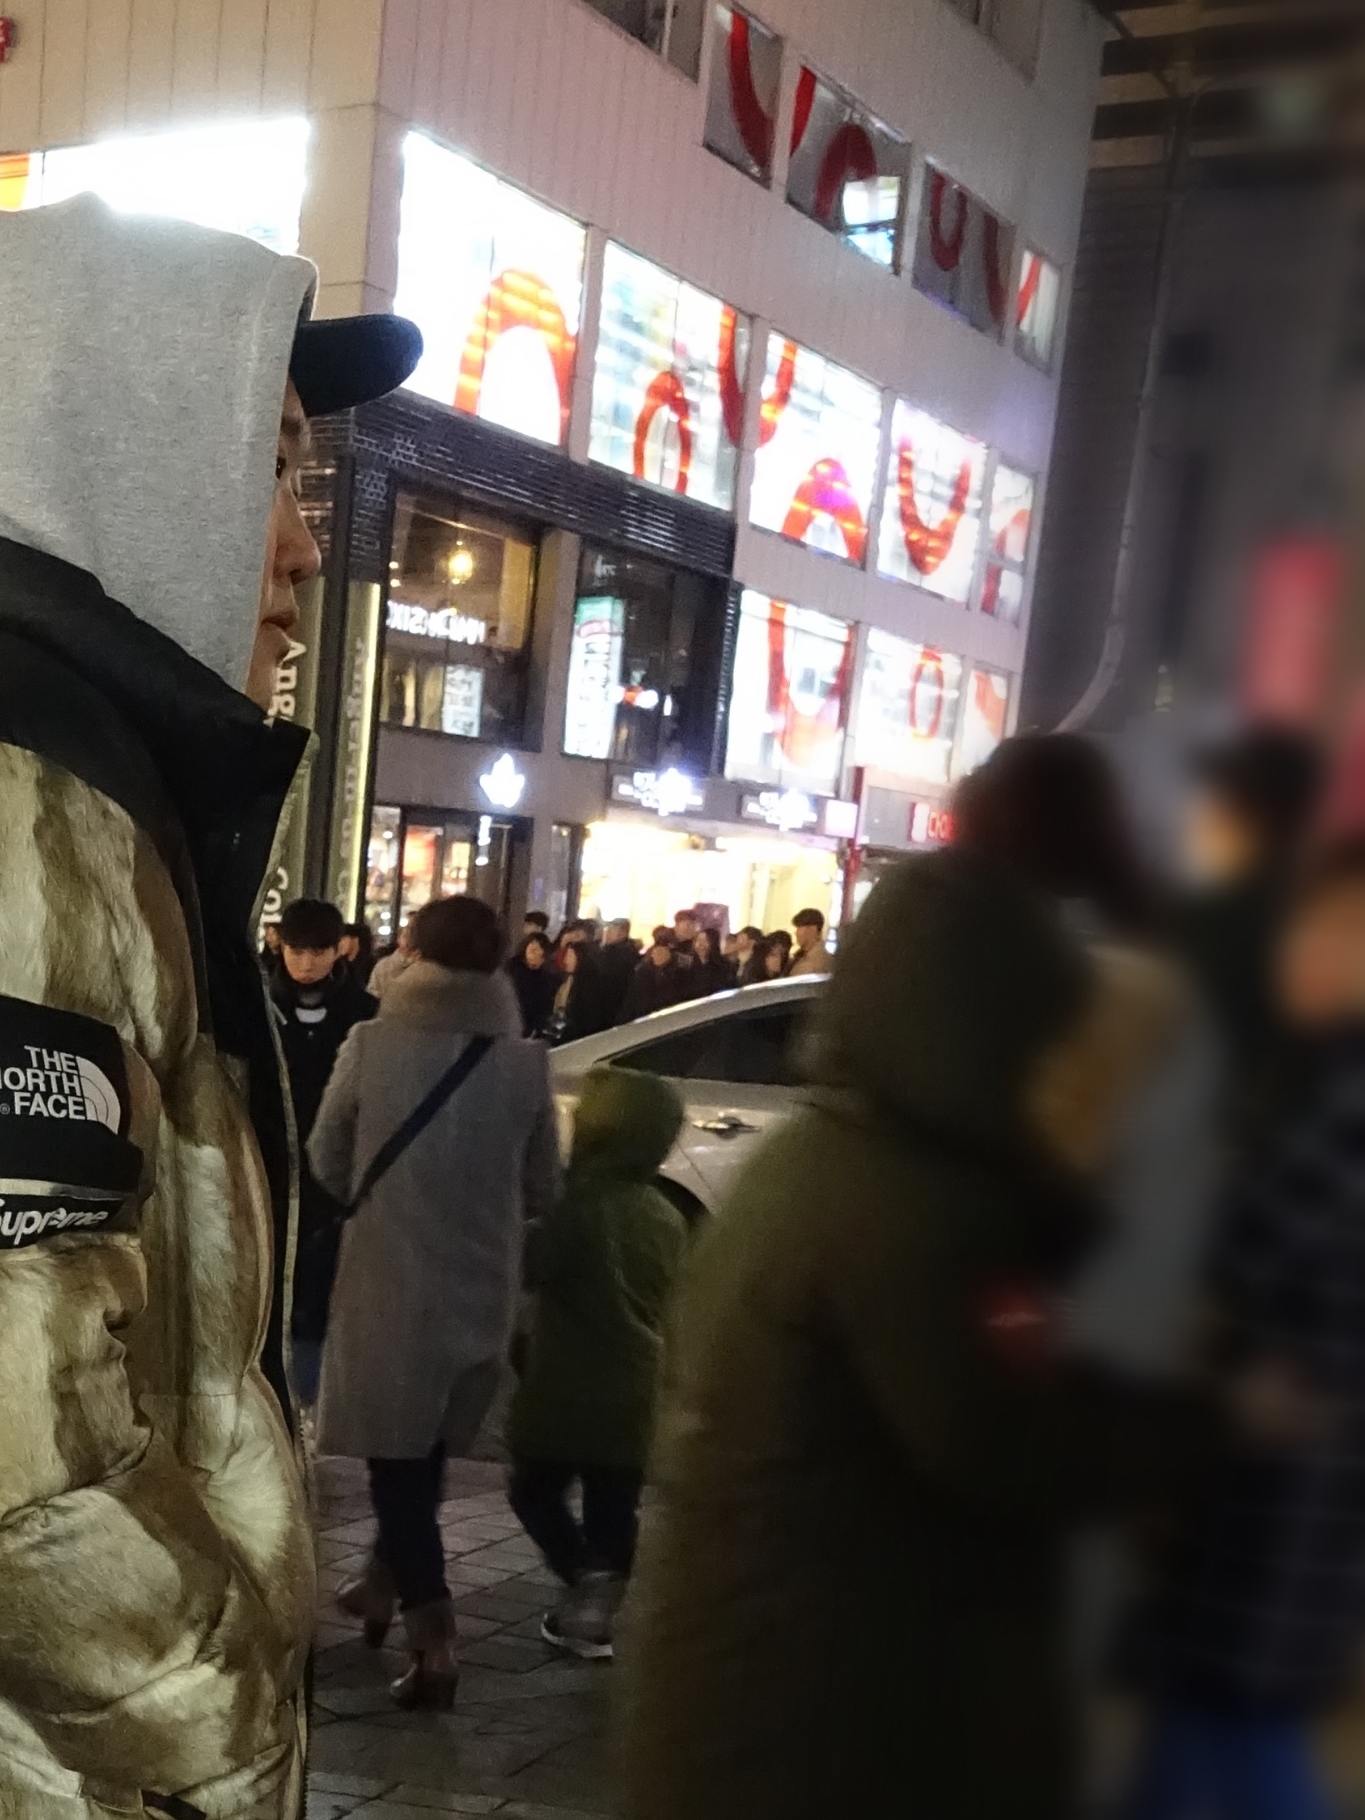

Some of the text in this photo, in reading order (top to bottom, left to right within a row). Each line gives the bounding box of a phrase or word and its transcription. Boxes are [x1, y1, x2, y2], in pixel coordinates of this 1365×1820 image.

[263, 633, 307, 728] Ang
[24, 1045, 78, 1075] THE
[14, 1092, 86, 1120] FACE
